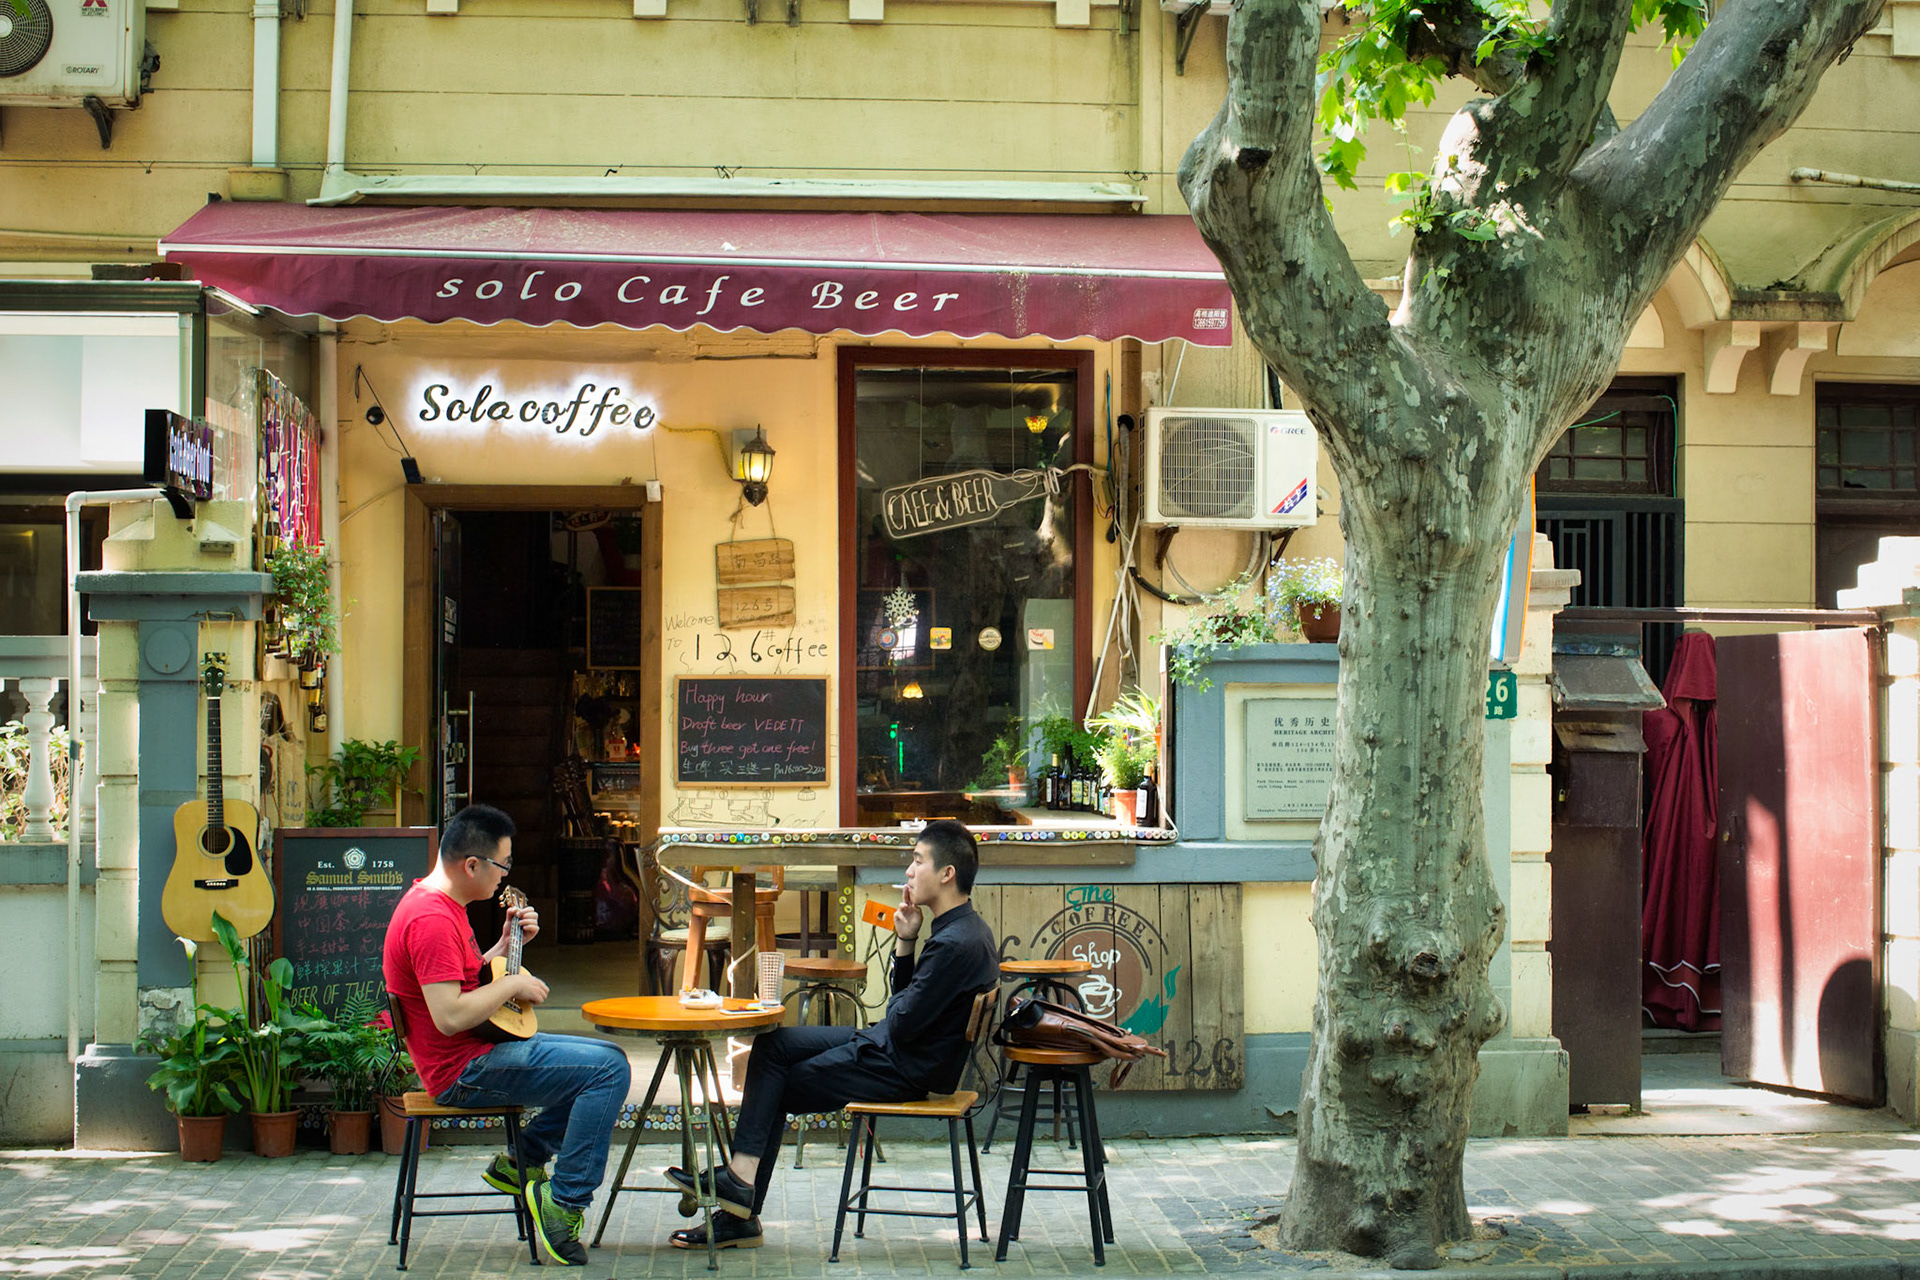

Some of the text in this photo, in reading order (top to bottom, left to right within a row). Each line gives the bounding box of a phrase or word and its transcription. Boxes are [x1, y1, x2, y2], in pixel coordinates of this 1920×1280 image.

[72, 66, 100, 74] ROTARY
[435, 270, 959, 315] solo Cafe Beer
[1280, 427, 1307, 435] GREE
[952, 477, 999, 516] BEER
[733, 552, 782, 568] 南昌路
[736, 597, 774, 612] 126号
[665, 611, 715, 631] Welcome
[685, 682, 770, 714] Happy hour
[681, 716, 717, 737] Draft
[721, 717, 747, 731] beer
[701, 740, 734, 754] three
[761, 746, 782, 754] one
[372, 860, 395, 868] 1758
[305, 871, 404, 886] Samuel Smith's
[1066, 885, 1116, 911] The
[297, 911, 350, 938] 中国茶
[1050, 906, 1149, 939] COFFEE
[1072, 941, 1121, 970] Shop
[296, 956, 360, 981] 鲜榨果汁
[290, 985, 318, 1009] BEER
[323, 983, 340, 1005] OF
[345, 981, 375, 1002] THE
[1164, 1038, 1236, 1077] 126
